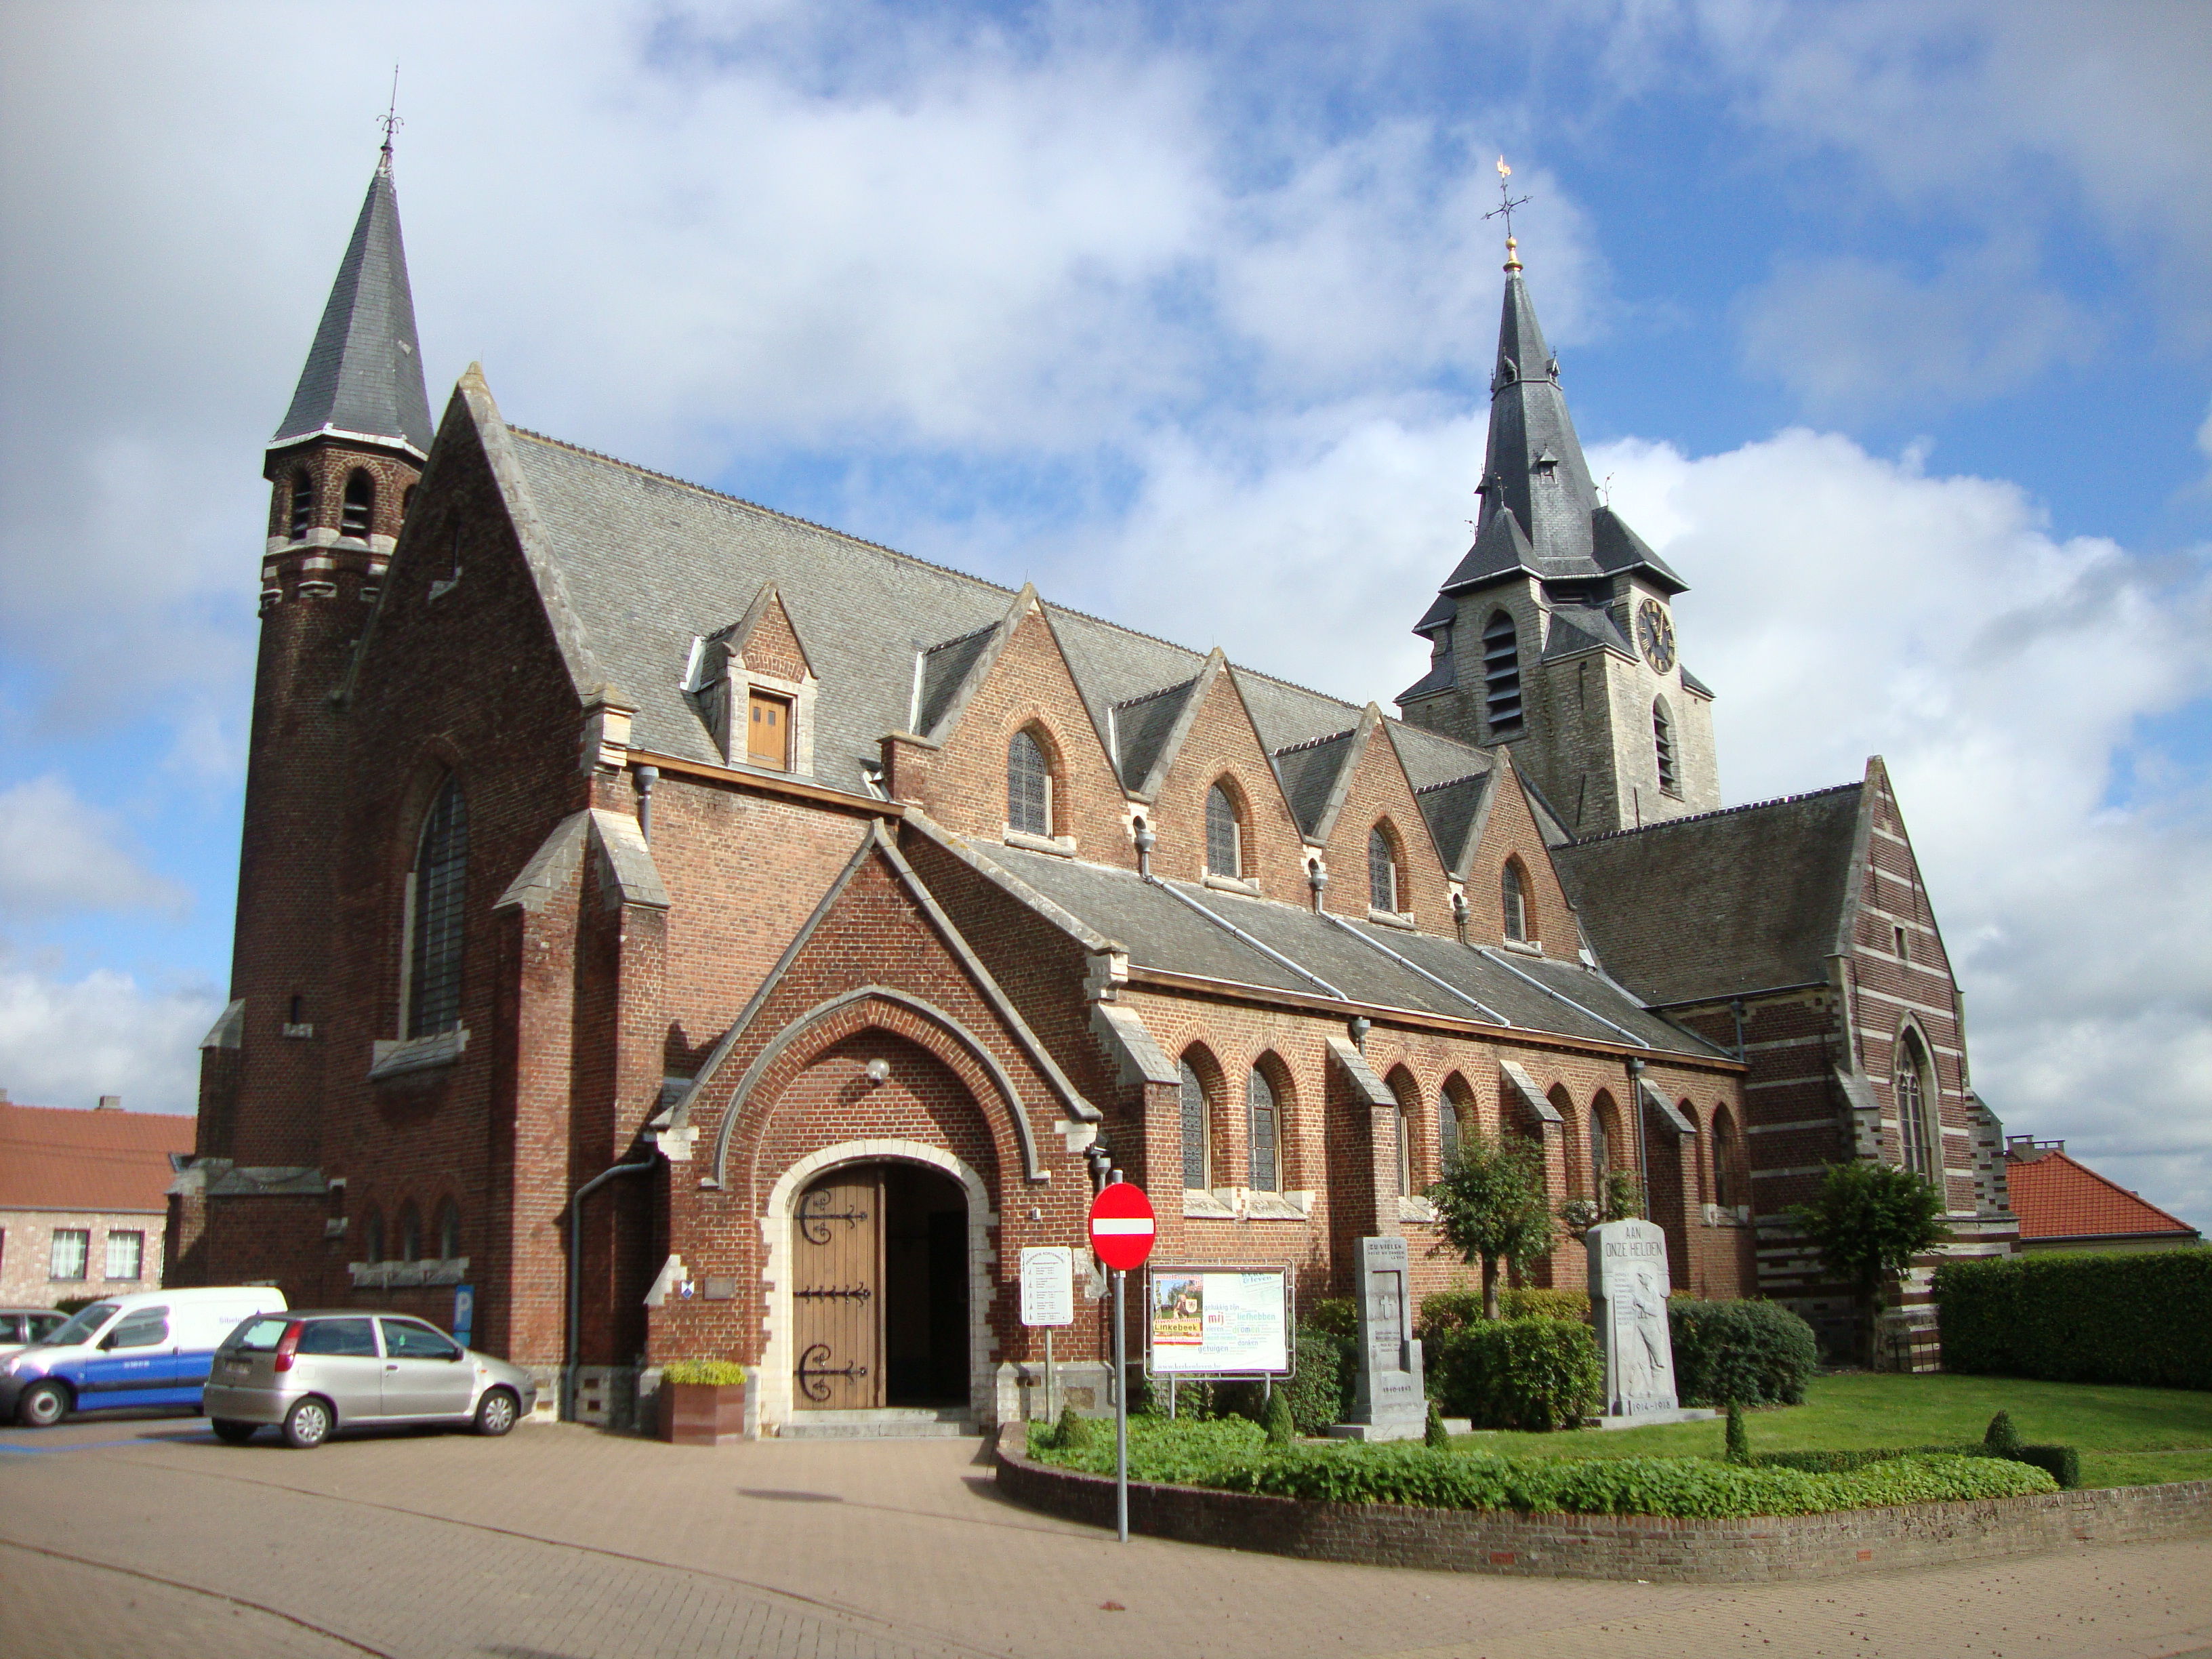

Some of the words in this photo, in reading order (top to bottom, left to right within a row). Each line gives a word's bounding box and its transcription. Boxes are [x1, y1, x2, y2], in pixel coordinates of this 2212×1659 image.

[1626, 1227, 1641, 1240] AAN
[1606, 1242, 1627, 1257] ONZE
[1630, 1242, 1662, 1256] HELDEN
[456, 1291, 472, 1324] P
[1208, 1311, 1225, 1326] mij
[1237, 1311, 1276, 1321] liefhebben
[1154, 1323, 1198, 1331] Linkebeek
[1232, 1326, 1261, 1334] dromen
[1197, 1344, 1229, 1353] getuigen
